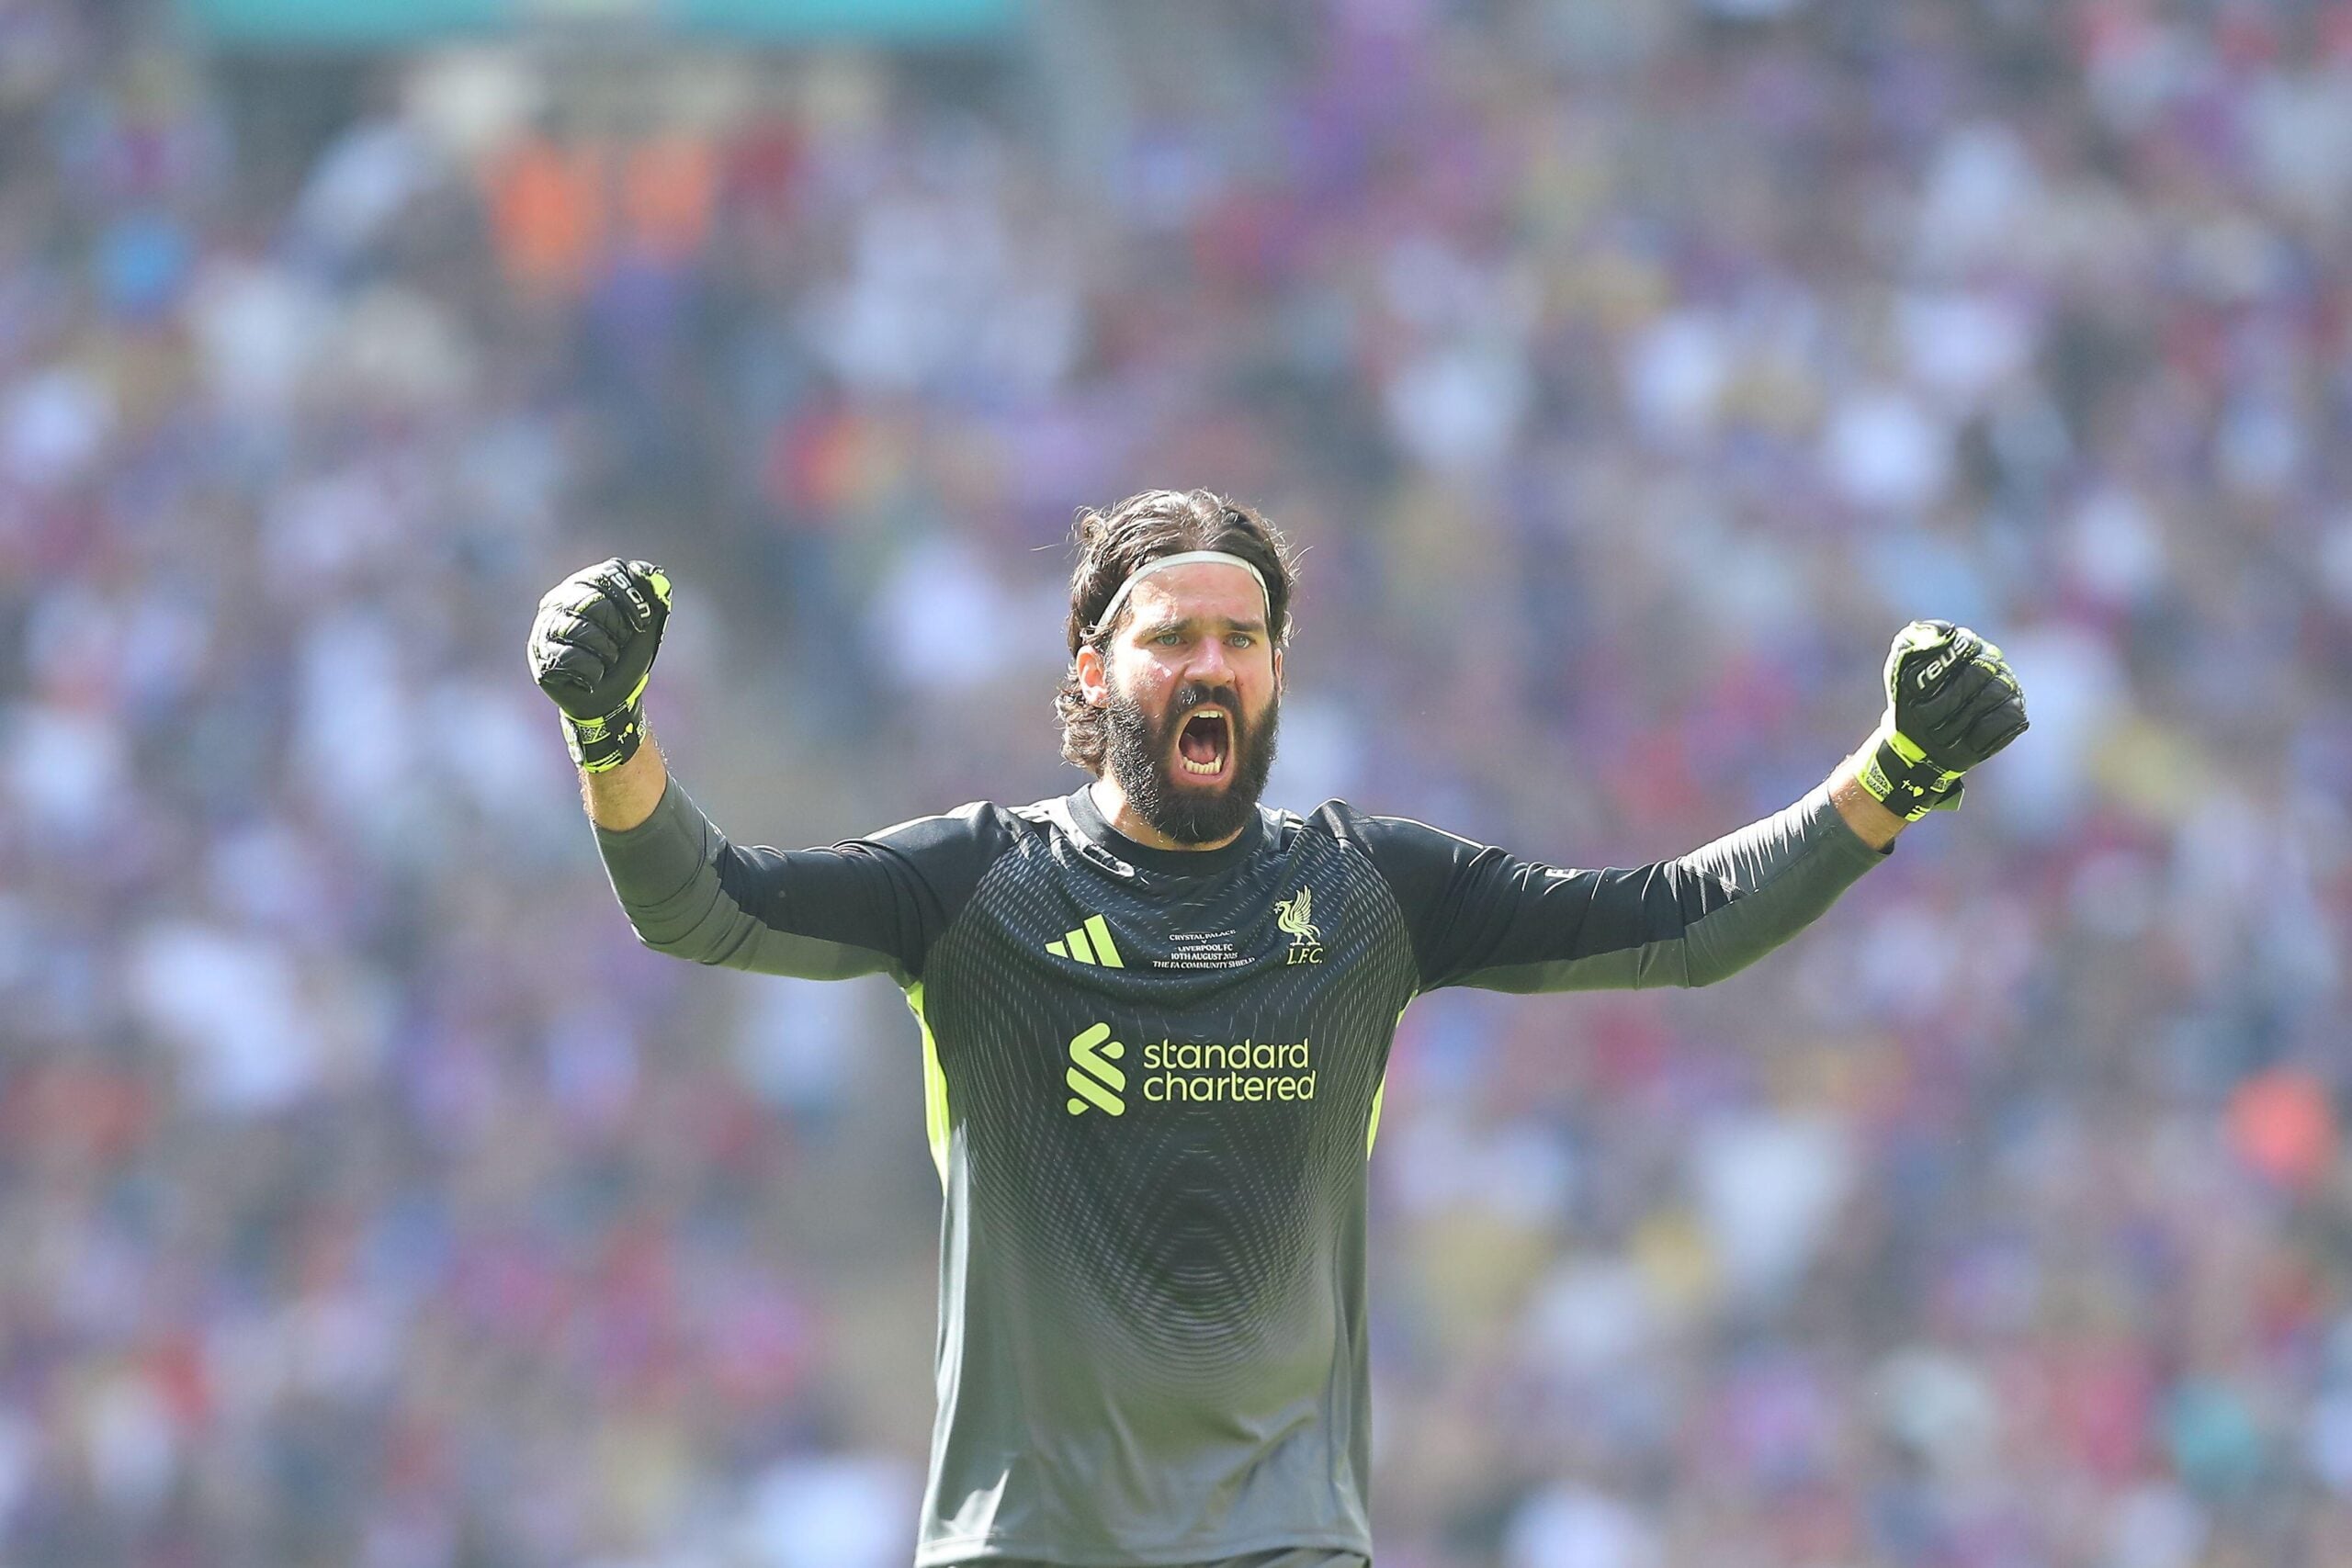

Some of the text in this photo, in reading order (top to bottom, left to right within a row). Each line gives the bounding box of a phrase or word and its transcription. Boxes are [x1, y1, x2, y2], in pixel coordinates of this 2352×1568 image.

[1204, 929, 1237, 939] PALACE
[1223, 943, 1234, 952] FC
[1152, 956, 1256, 969] THE FA COMMUNITY SHIELD
[1143, 1038, 1308, 1069] standard
[1143, 1070, 1317, 1101] chartered
